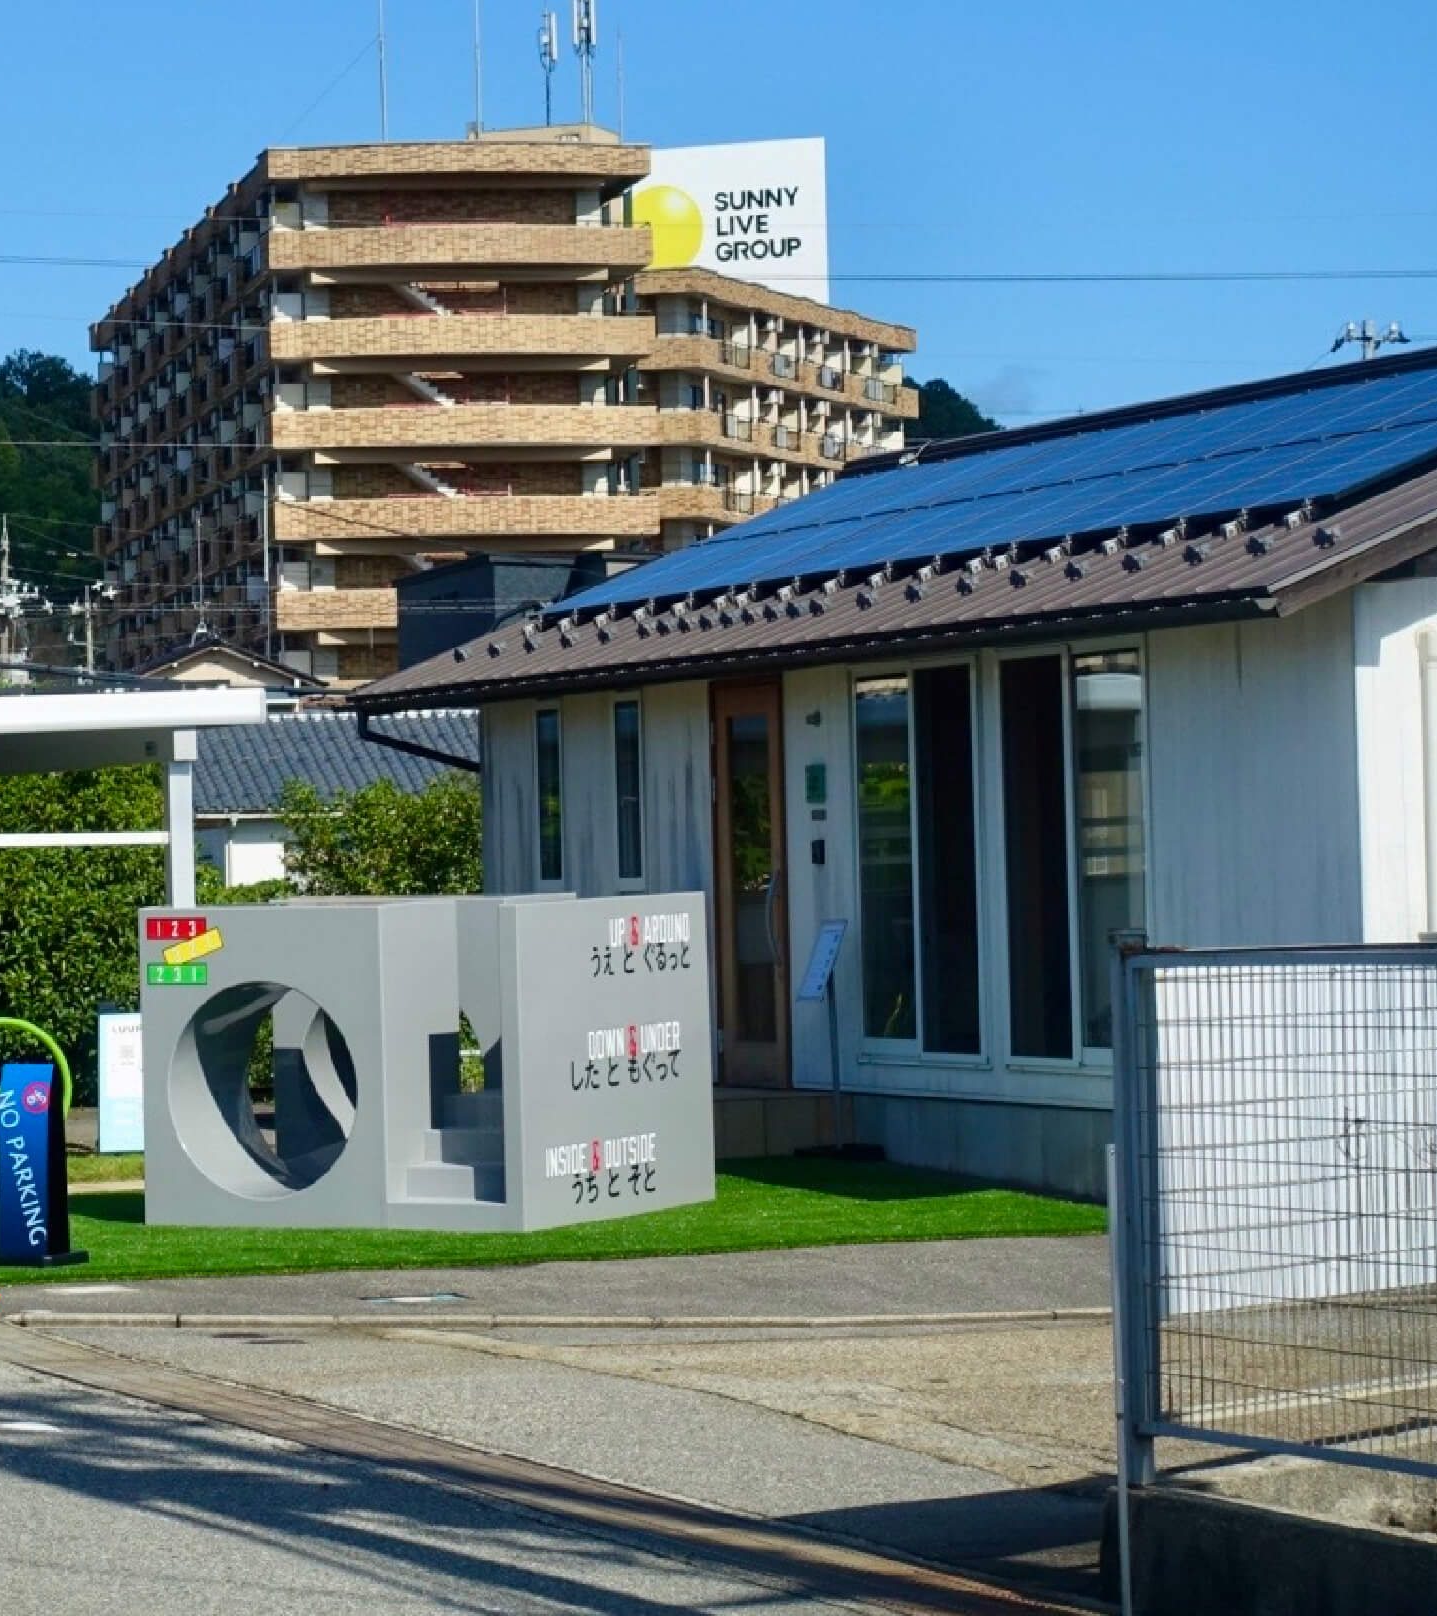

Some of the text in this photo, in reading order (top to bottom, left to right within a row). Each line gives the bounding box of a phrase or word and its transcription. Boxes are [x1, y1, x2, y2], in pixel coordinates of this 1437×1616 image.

[714, 186, 799, 212] SUNNY
[716, 214, 769, 237] LIVE
[715, 237, 802, 262] GROUP
[609, 918, 624, 948] UP
[644, 912, 690, 944] AROUND
[588, 1028, 625, 1061] DOWN
[640, 1021, 680, 1054] UNDER
[545, 1143, 588, 1178] INSIDE
[605, 1132, 656, 1170] OUTSIDE
[5, 1135, 47, 1247] PARKING
